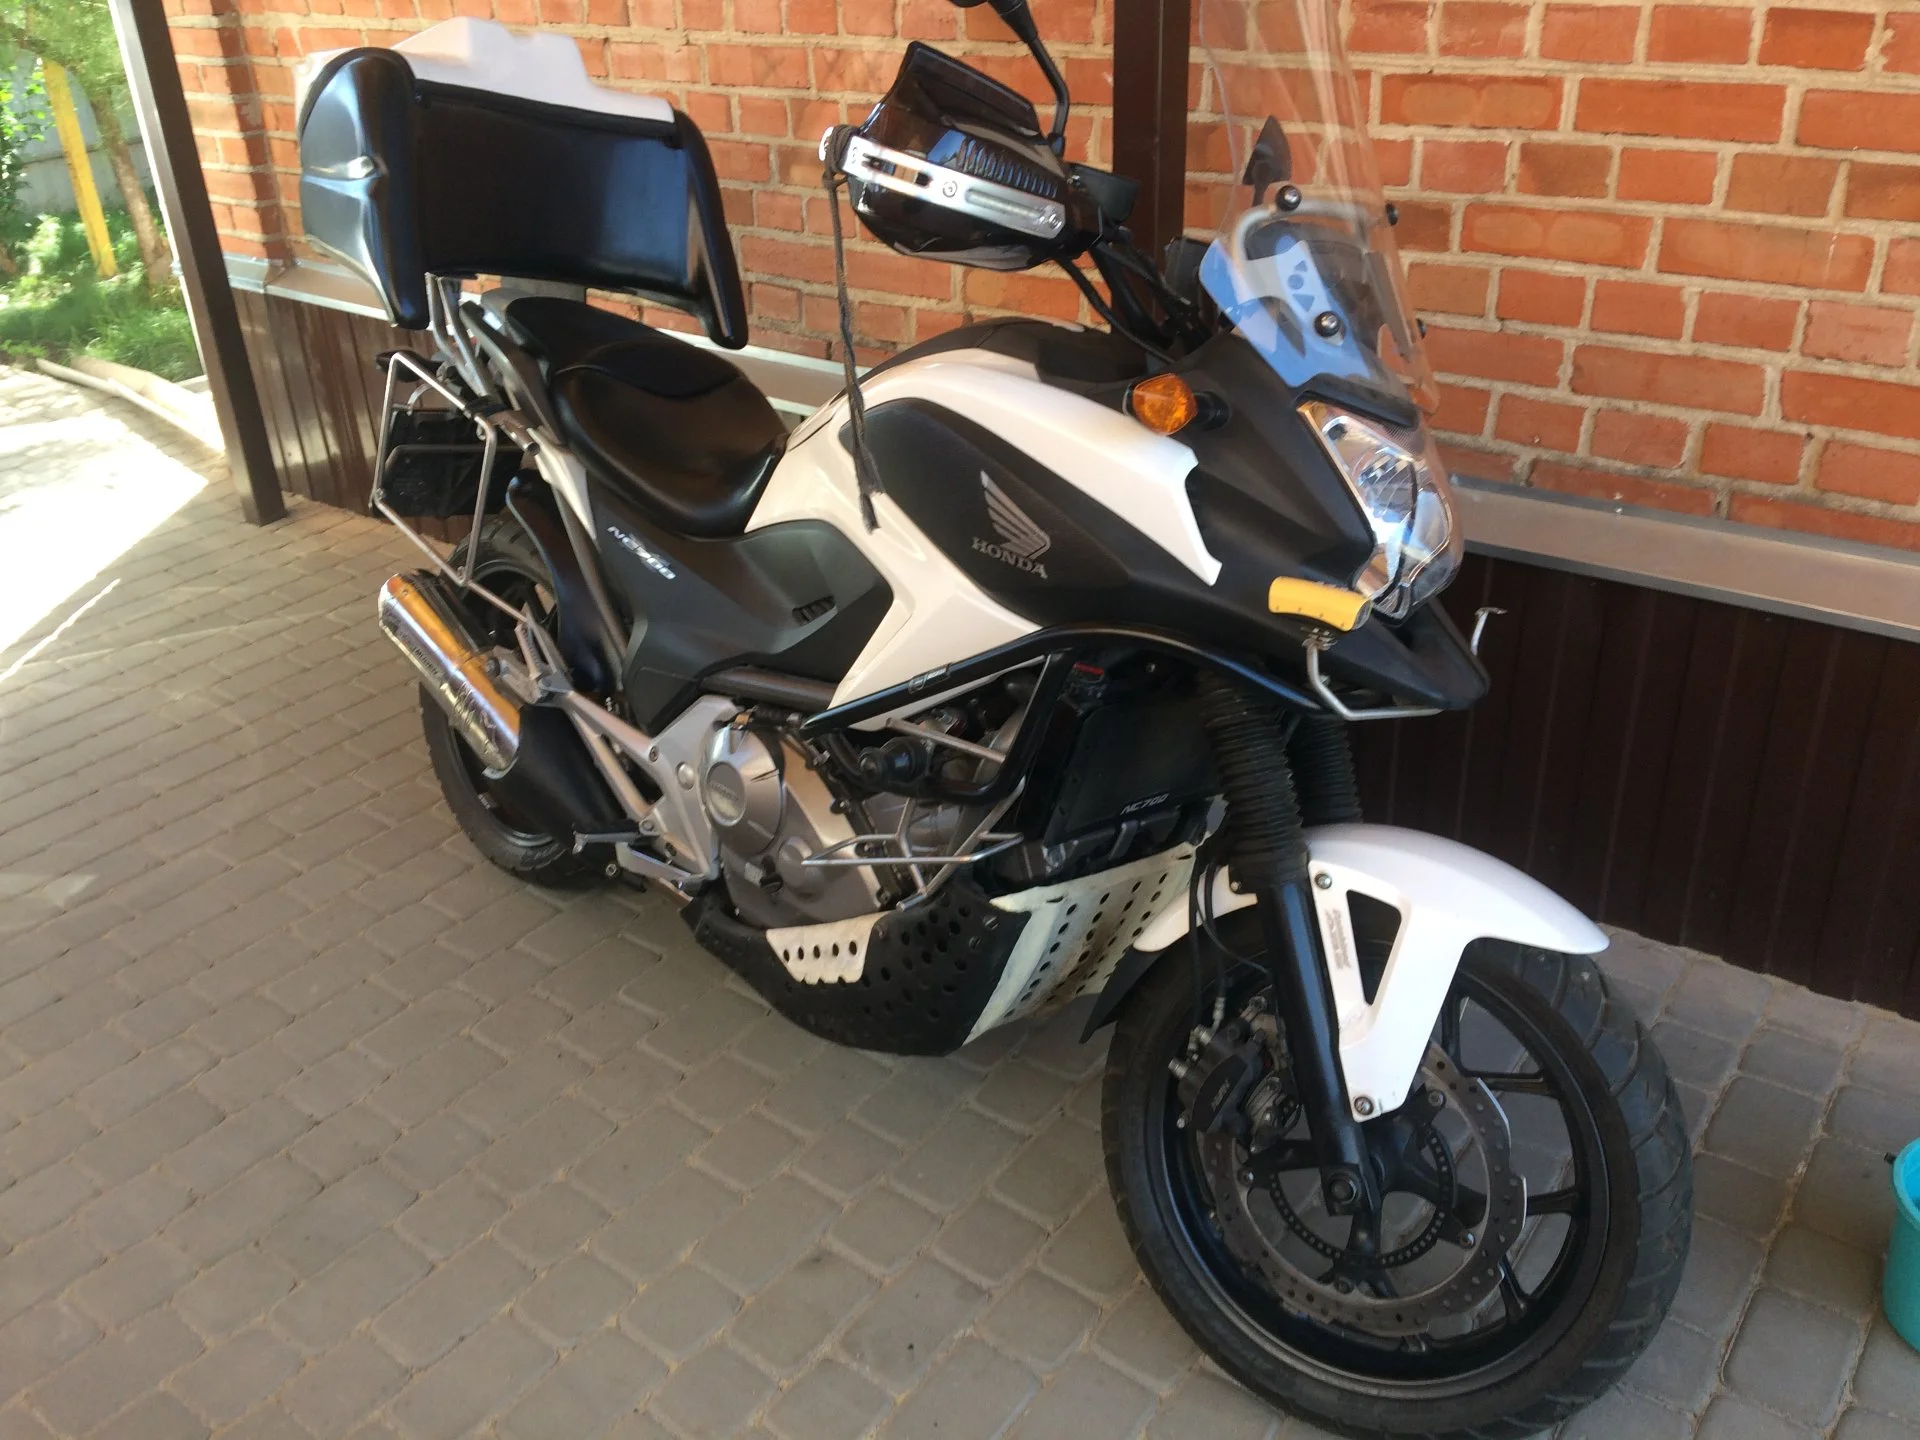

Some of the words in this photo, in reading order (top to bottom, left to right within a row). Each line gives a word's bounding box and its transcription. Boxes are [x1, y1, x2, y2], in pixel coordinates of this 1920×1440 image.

[608, 526, 676, 579] NC700
[972, 537, 1048, 579] HONDA
[1120, 793, 1170, 815] NC700
